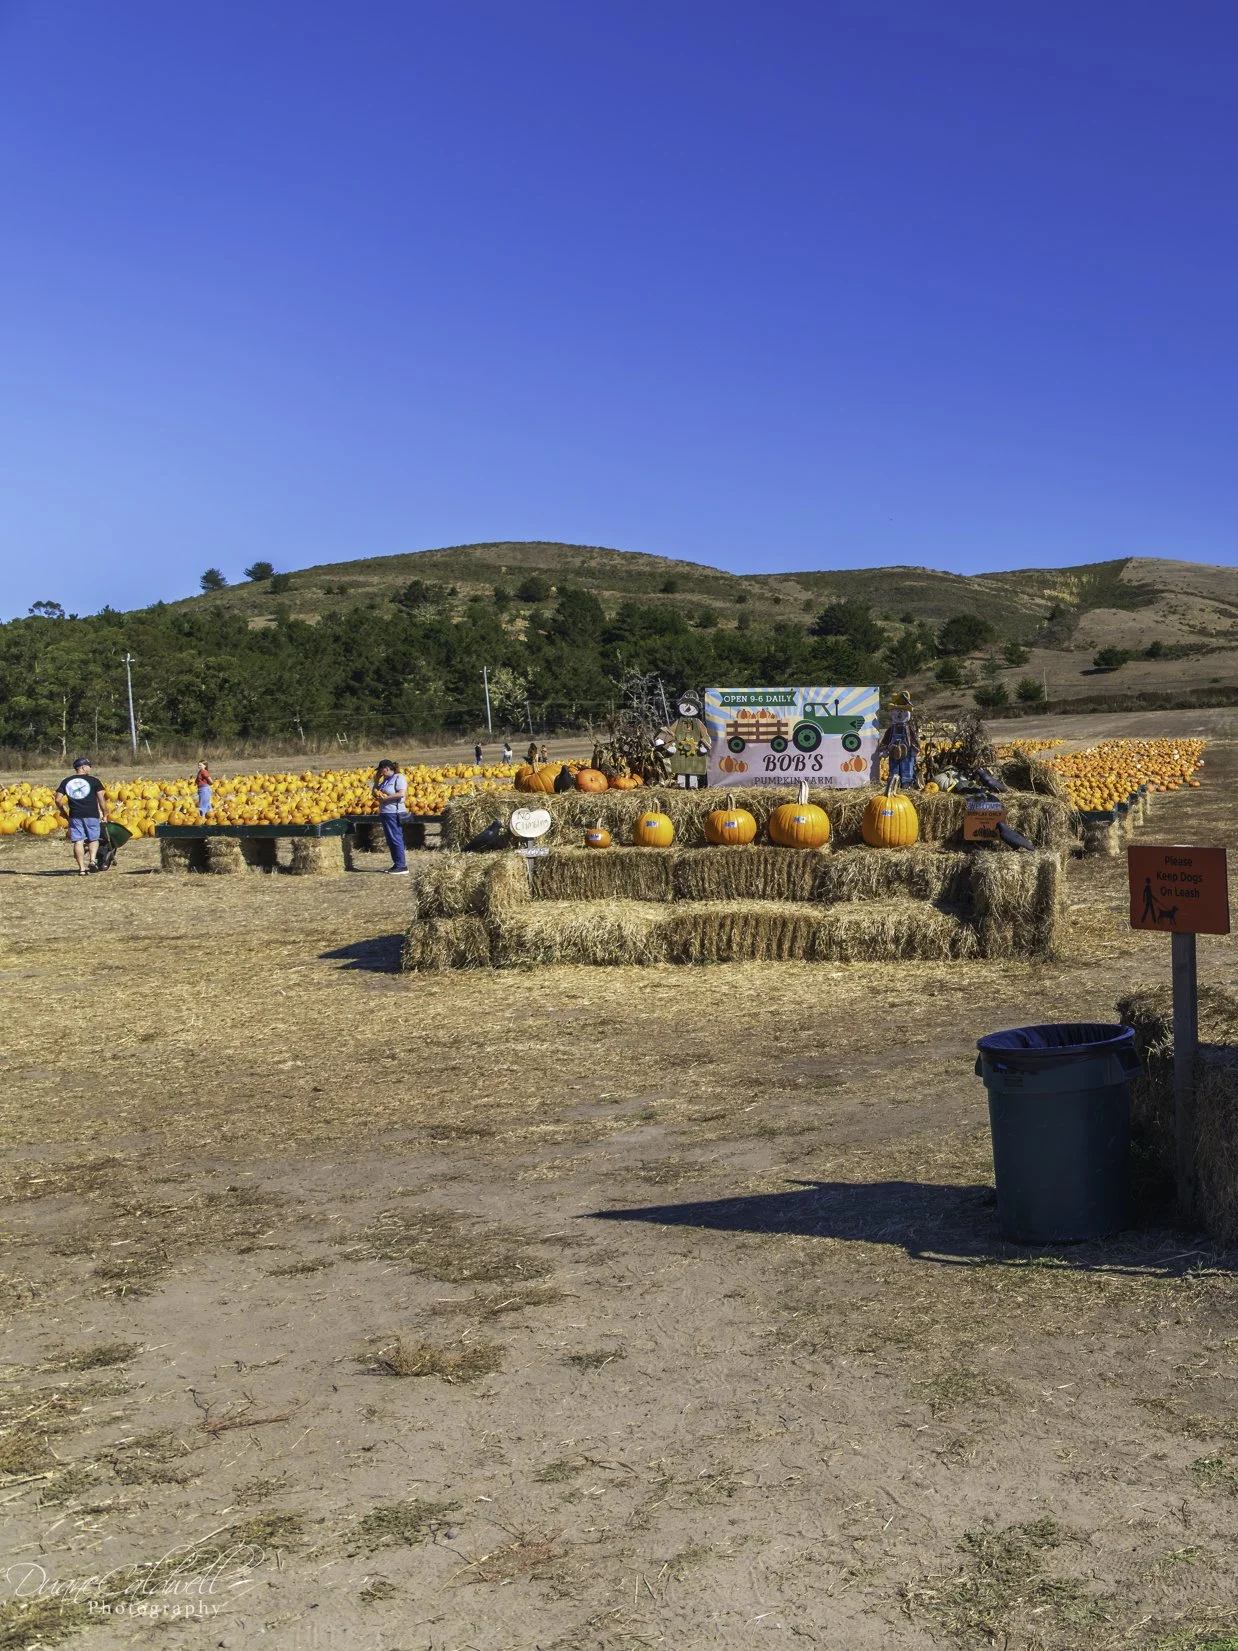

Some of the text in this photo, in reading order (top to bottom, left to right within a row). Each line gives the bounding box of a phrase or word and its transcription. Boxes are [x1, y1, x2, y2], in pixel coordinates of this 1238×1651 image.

[723, 695, 792, 703] OPEN 9-6 DAILY
[763, 753, 823, 772] BOB'S
[754, 776, 833, 785] PUMPKIN FARM
[517, 811, 531, 821] NO
[1165, 856, 1193, 867] Please
[1156, 871, 1203, 885] Keep Dogs
[1160, 886, 1200, 898] On Leash
